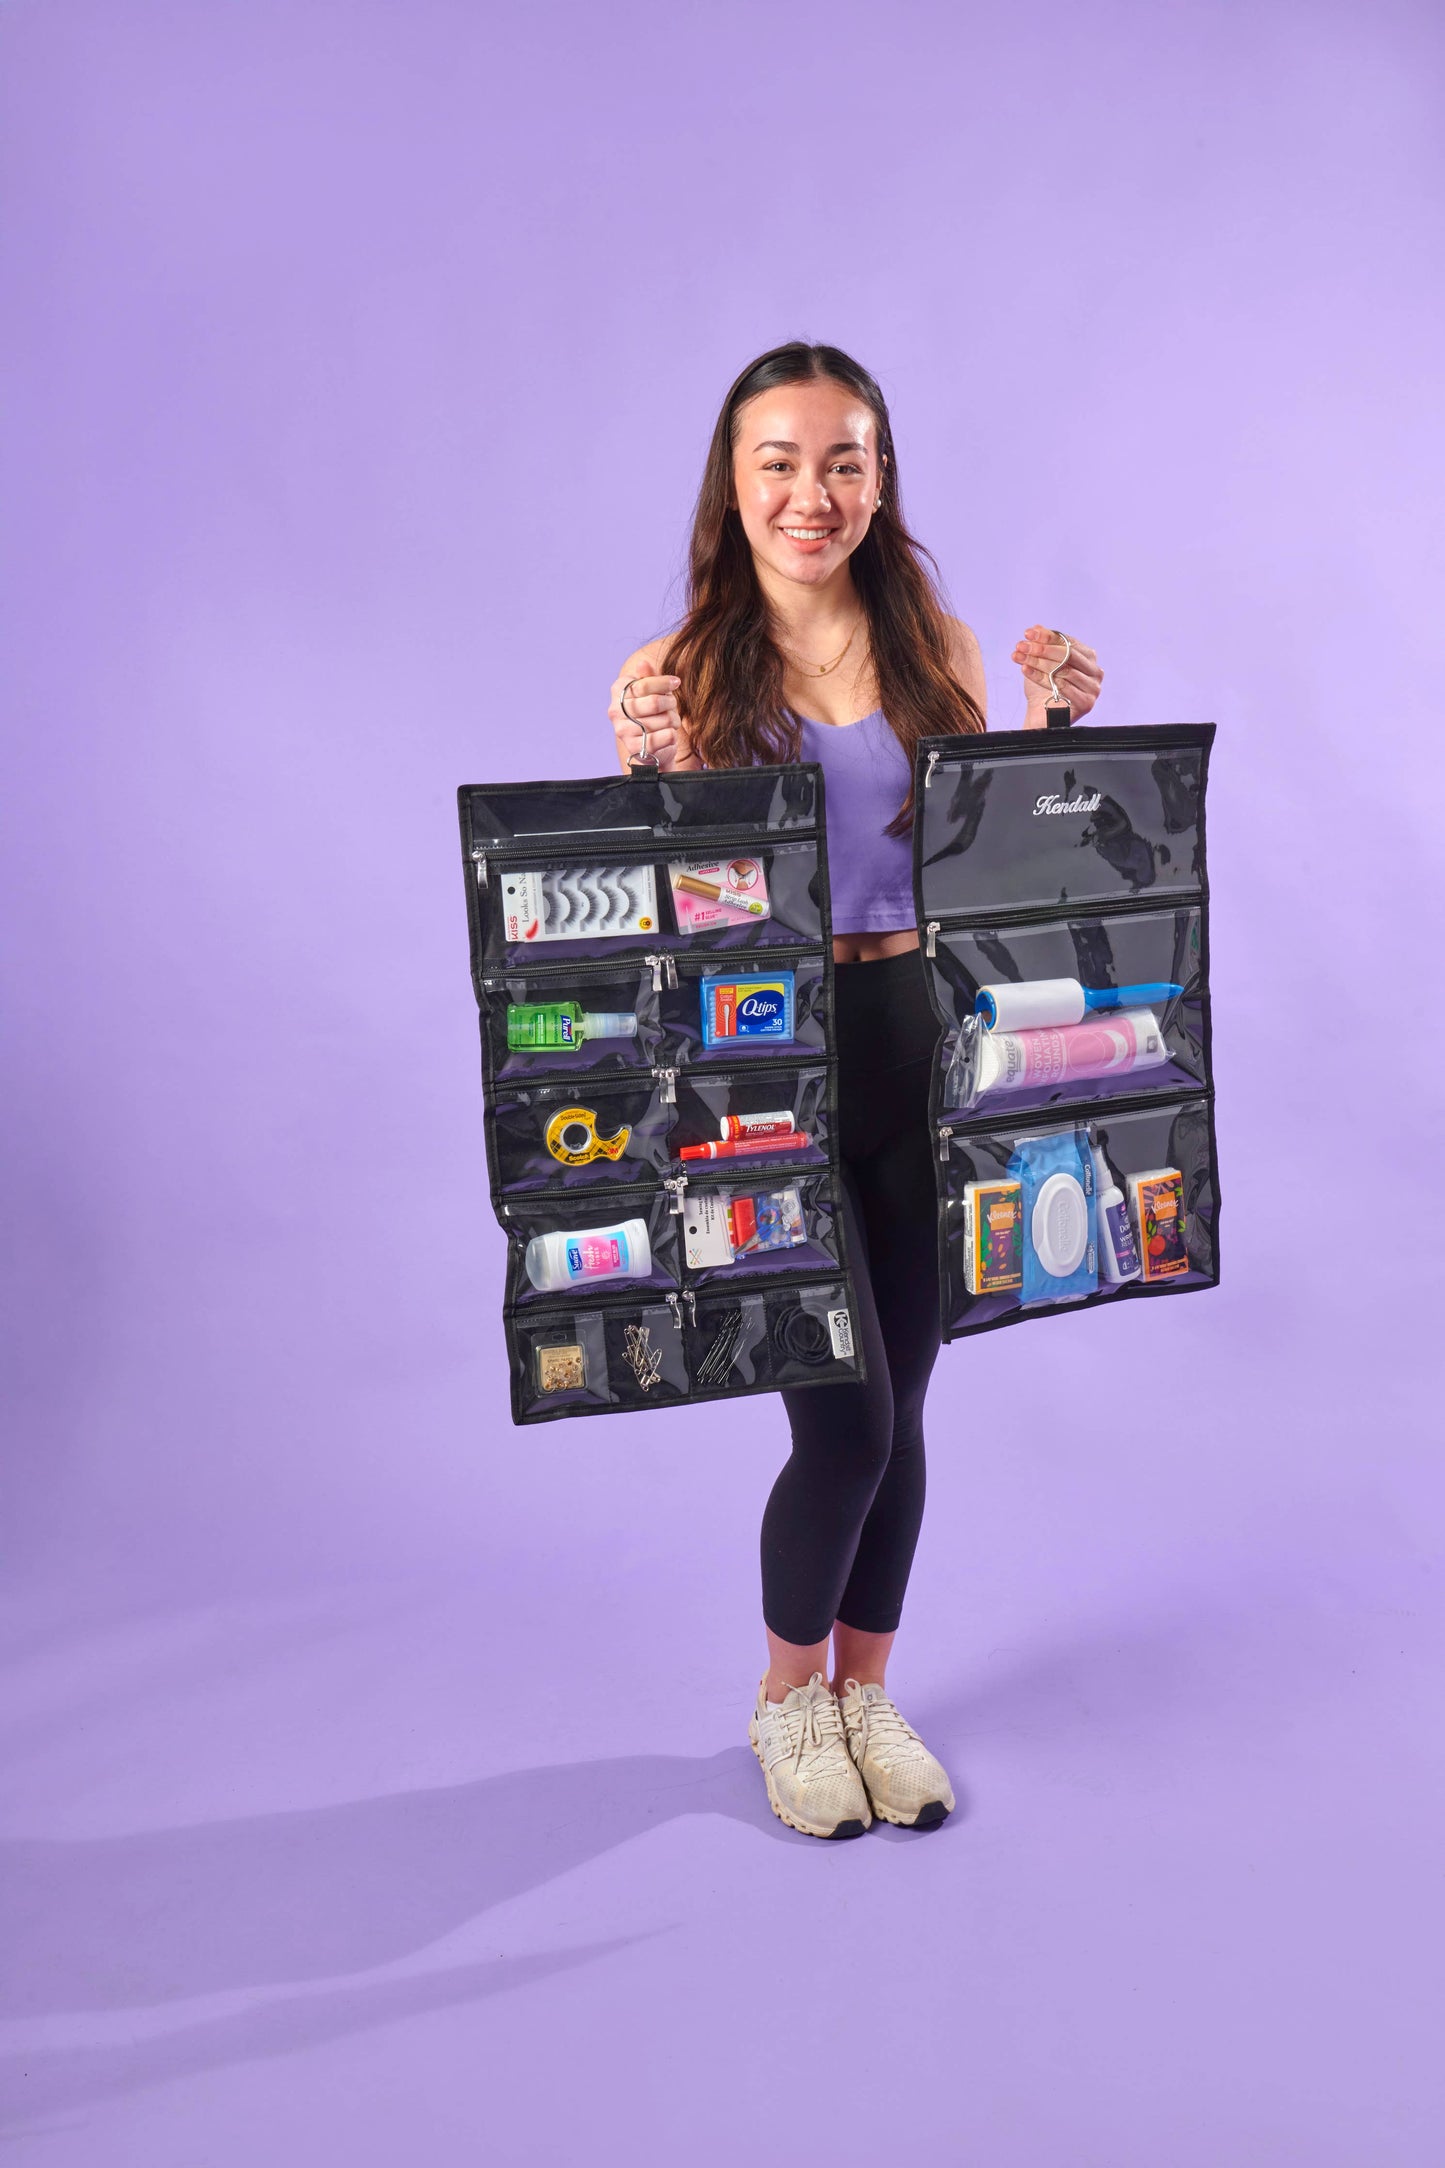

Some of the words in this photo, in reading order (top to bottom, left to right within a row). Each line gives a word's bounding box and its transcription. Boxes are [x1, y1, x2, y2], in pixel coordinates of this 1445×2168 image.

[1033, 793, 1101, 815] Kendall
[520, 886, 528, 897] So
[521, 899, 530, 922] Looks
[694, 911, 705, 921] #1
[510, 915, 518, 940] KISS
[562, 1018, 571, 1041] Purell
[772, 1018, 783, 1026] 30
[1005, 1039, 1018, 1083] equate
[1032, 1038, 1042, 1079] WOVEN
[1051, 1033, 1061, 1078] ROUNDS
[746, 1124, 775, 1133] TYLENOL
[607, 1147, 619, 1155] 3M
[1151, 1199, 1179, 1214] Kleenex
[987, 1210, 1017, 1224] Kleenex
[572, 1250, 580, 1270] Suave
